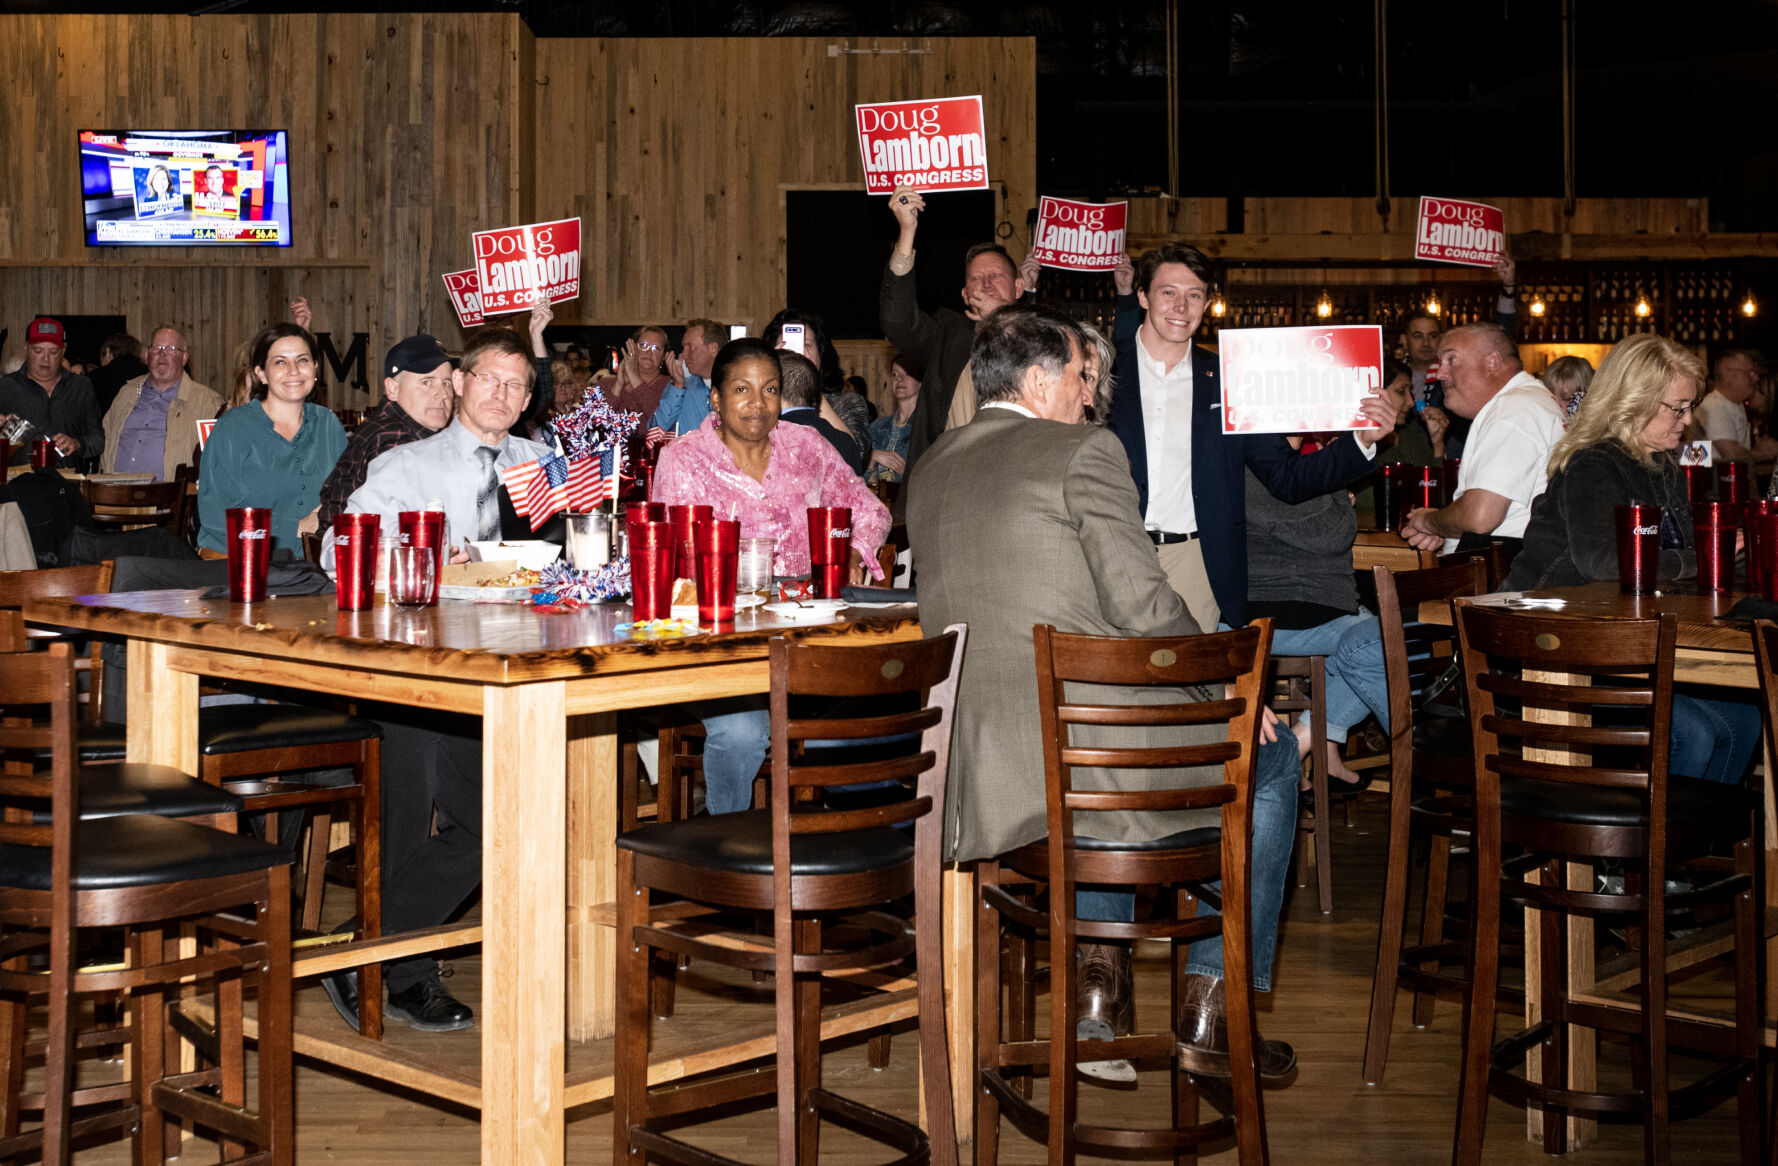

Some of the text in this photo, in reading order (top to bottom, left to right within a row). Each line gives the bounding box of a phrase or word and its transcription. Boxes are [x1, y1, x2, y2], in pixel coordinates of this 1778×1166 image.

[860, 105, 941, 135] Doug
[862, 131, 984, 173] Lamborn
[868, 168, 984, 187] U.S. CONGRESS
[1042, 199, 1105, 230] Doug
[1423, 199, 1485, 226] Doug
[477, 227, 555, 257] Doug
[1036, 218, 1125, 256] Lamborn
[1419, 216, 1504, 252] Lamborn
[1418, 245, 1504, 263] U.S. CONGRES
[479, 250, 578, 294] Lamborn
[484, 294, 509, 308] U.S.
[513, 280, 578, 305] CONGRESS
[462, 313, 484, 323] U.S.
[1229, 332, 1334, 365] Doug
[1226, 361, 1380, 408] Lamborn
